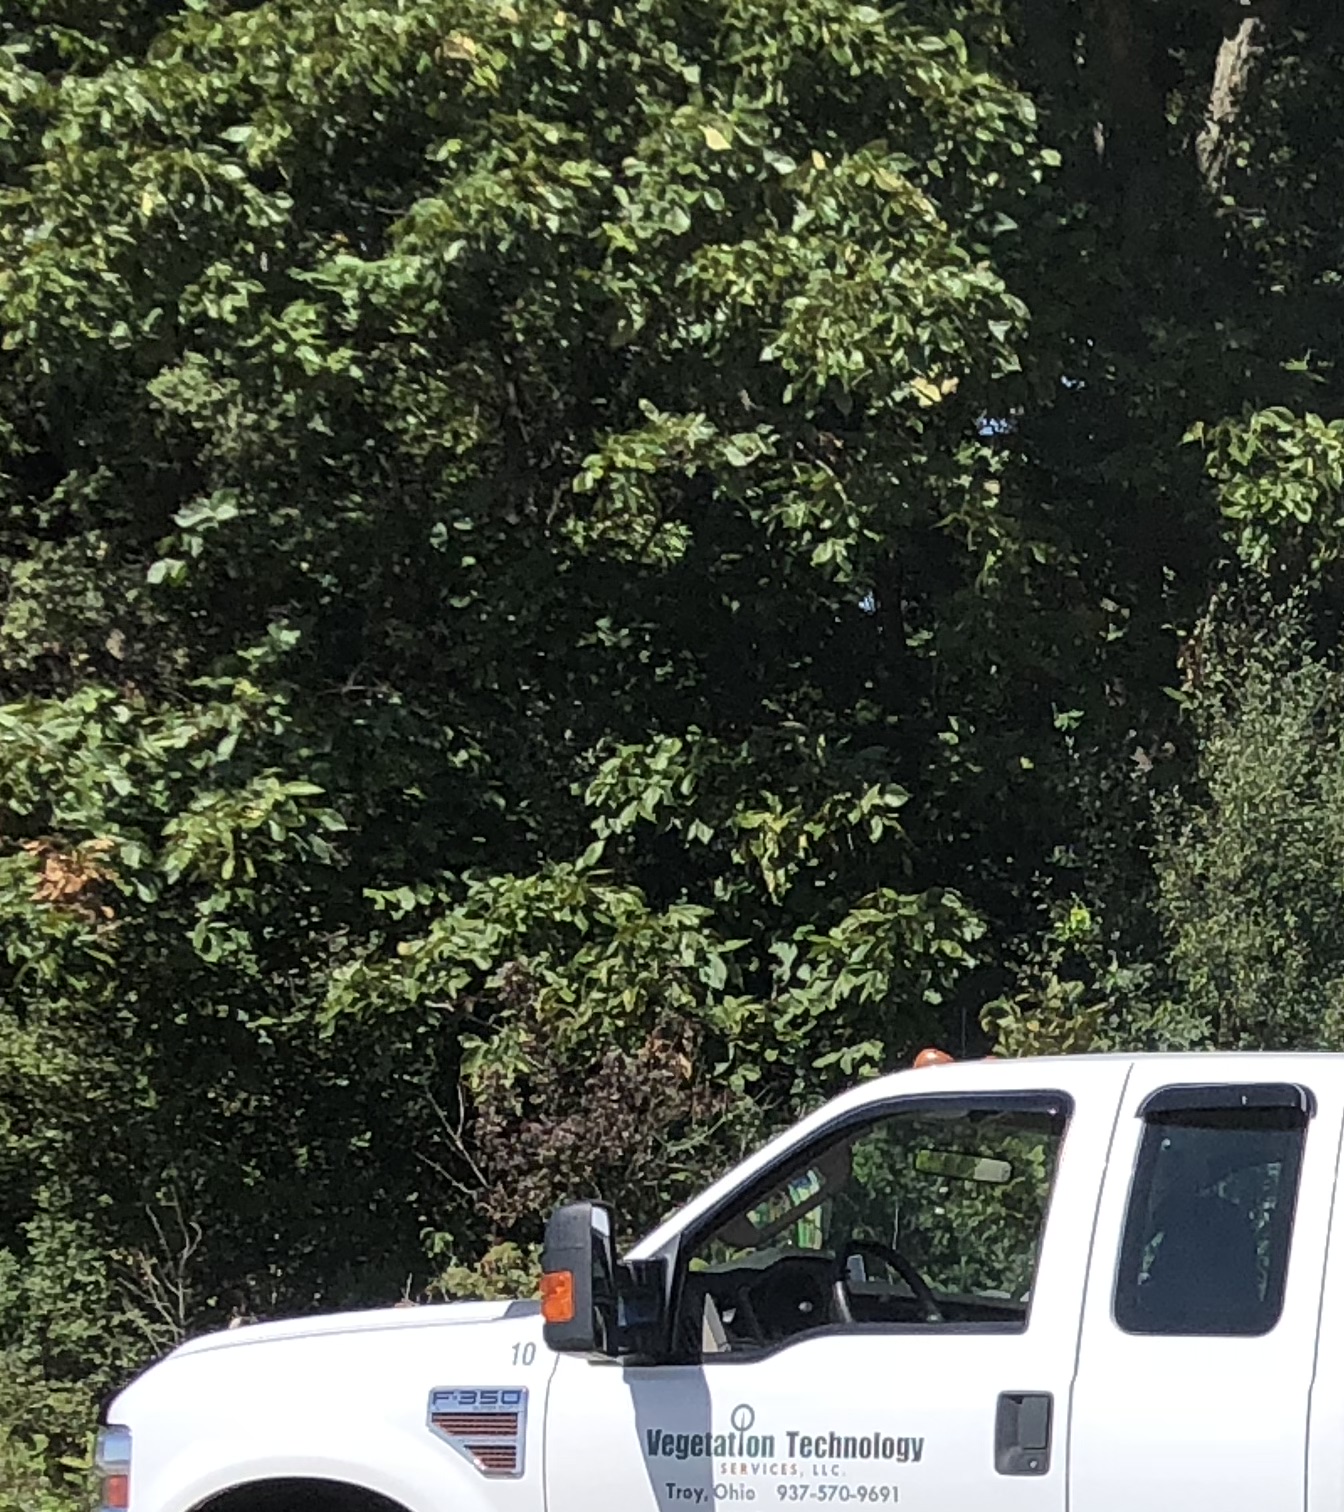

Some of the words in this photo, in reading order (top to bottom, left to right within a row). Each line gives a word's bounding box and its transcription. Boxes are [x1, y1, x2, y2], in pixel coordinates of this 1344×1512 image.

[512, 1341, 537, 1366] 10
[432, 1390, 522, 1405] F-350
[646, 1422, 775, 1461] Vegetation
[785, 1430, 925, 1463] Technology
[720, 1462, 805, 1478] SERVICES,
[665, 1482, 709, 1502] Troy,
[713, 1483, 756, 1501] Ohio
[776, 1484, 900, 1503] 937-570-9691
